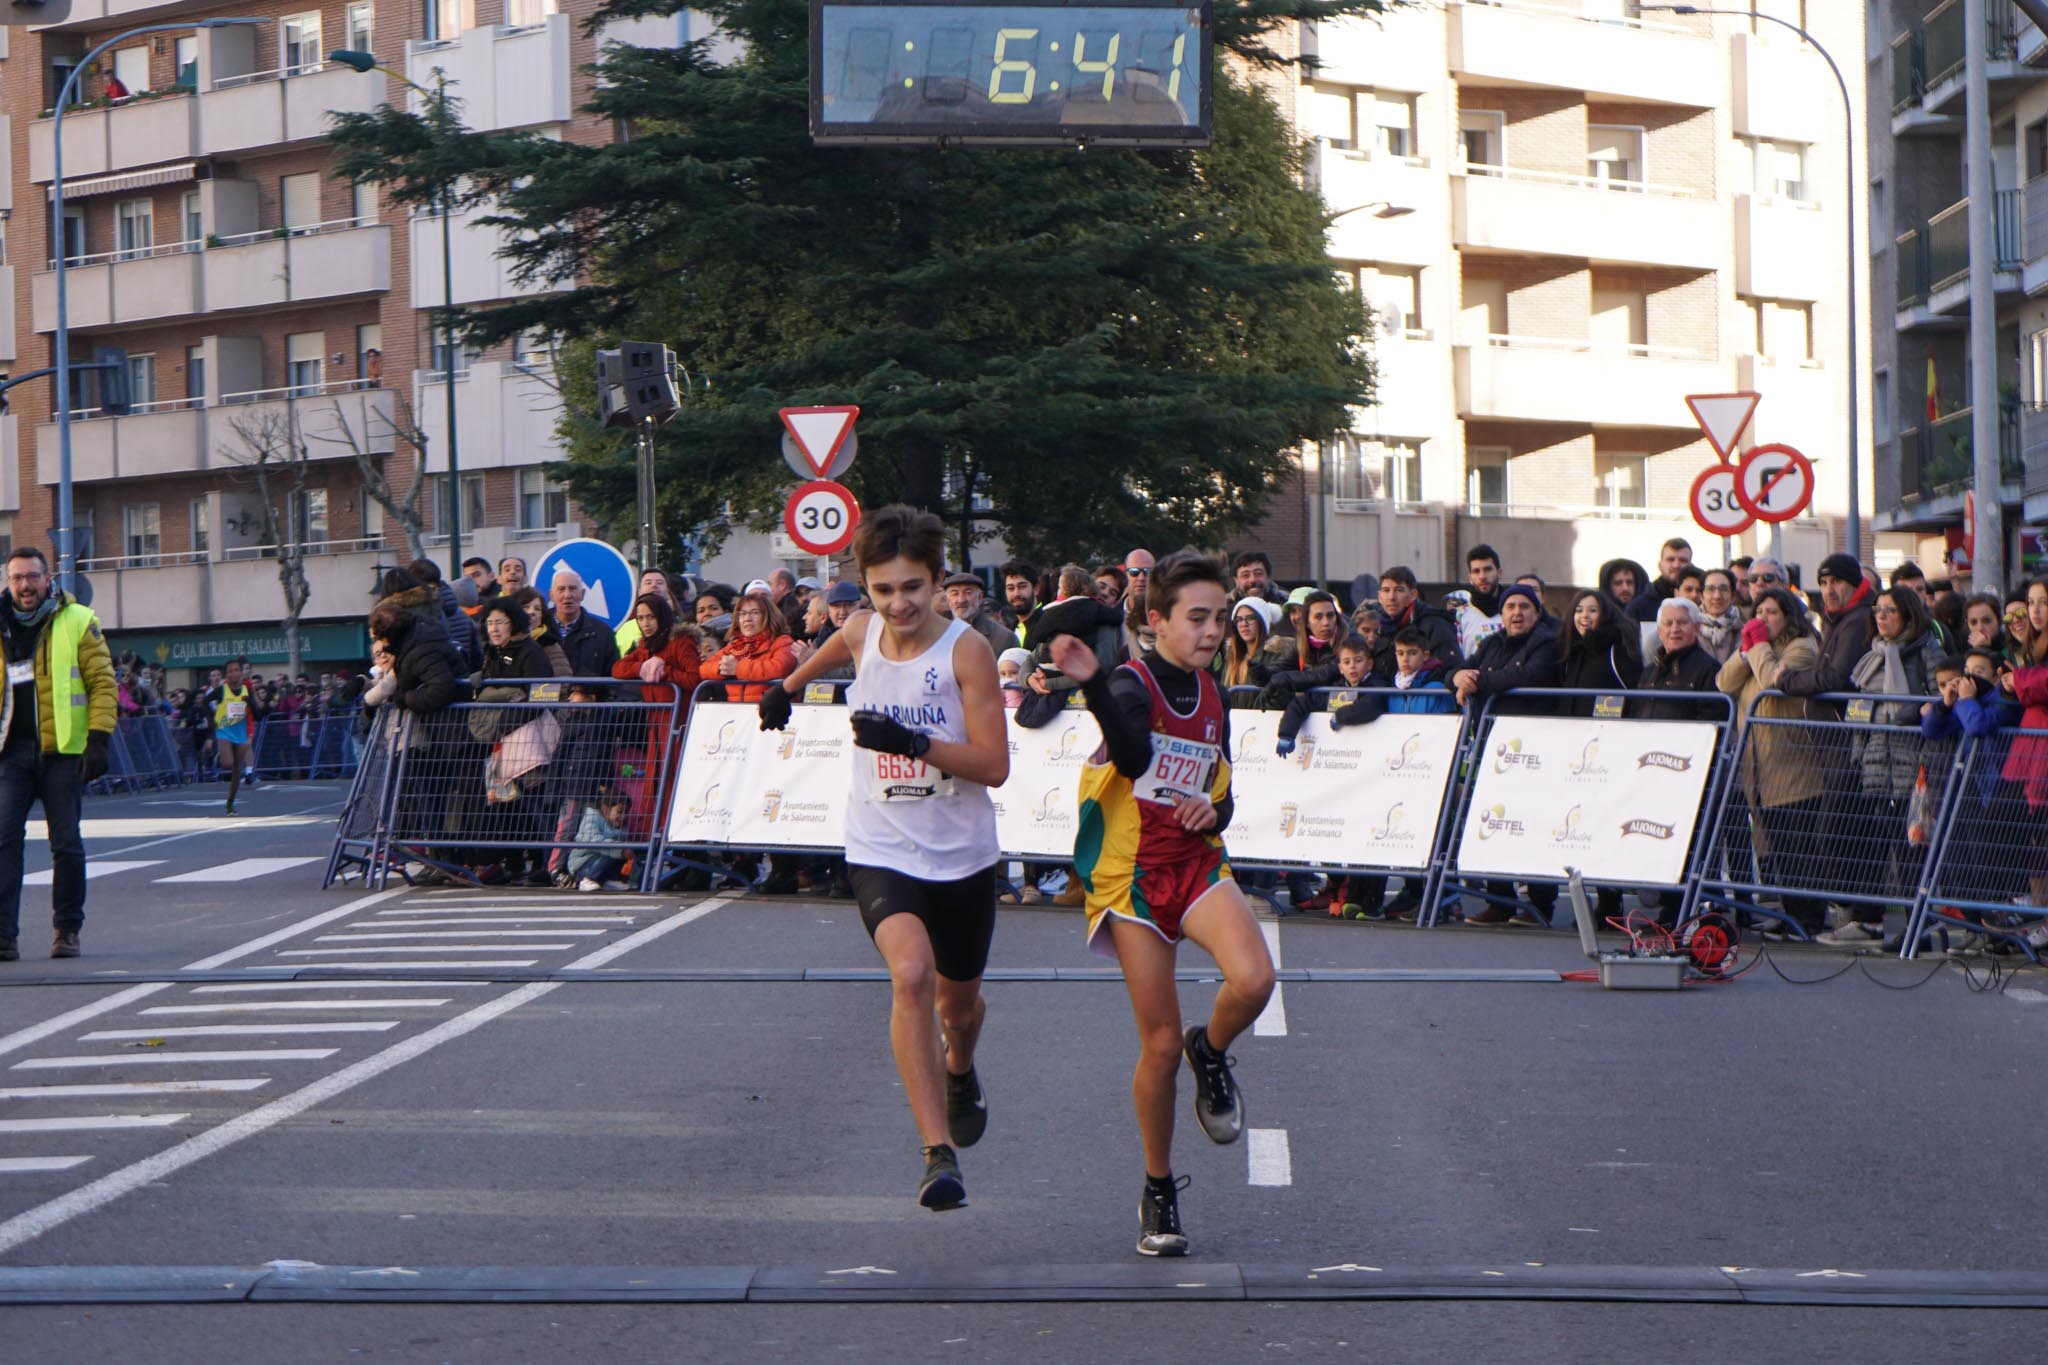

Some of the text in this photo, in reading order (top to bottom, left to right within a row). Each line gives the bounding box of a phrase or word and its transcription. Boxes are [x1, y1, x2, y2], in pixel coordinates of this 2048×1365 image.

[802, 506, 841, 530] 30
[173, 636, 312, 661] CAJA RURAL DE SALAMACA
[1316, 747, 1361, 759] Ayuntamiento
[1646, 752, 1683, 769] ALJOMAR
[877, 752, 927, 779] 6637
[1155, 753, 1202, 787] 6721
[1323, 760, 1358, 769] Salamanca
[1629, 820, 1666, 837] ALJOMAR
